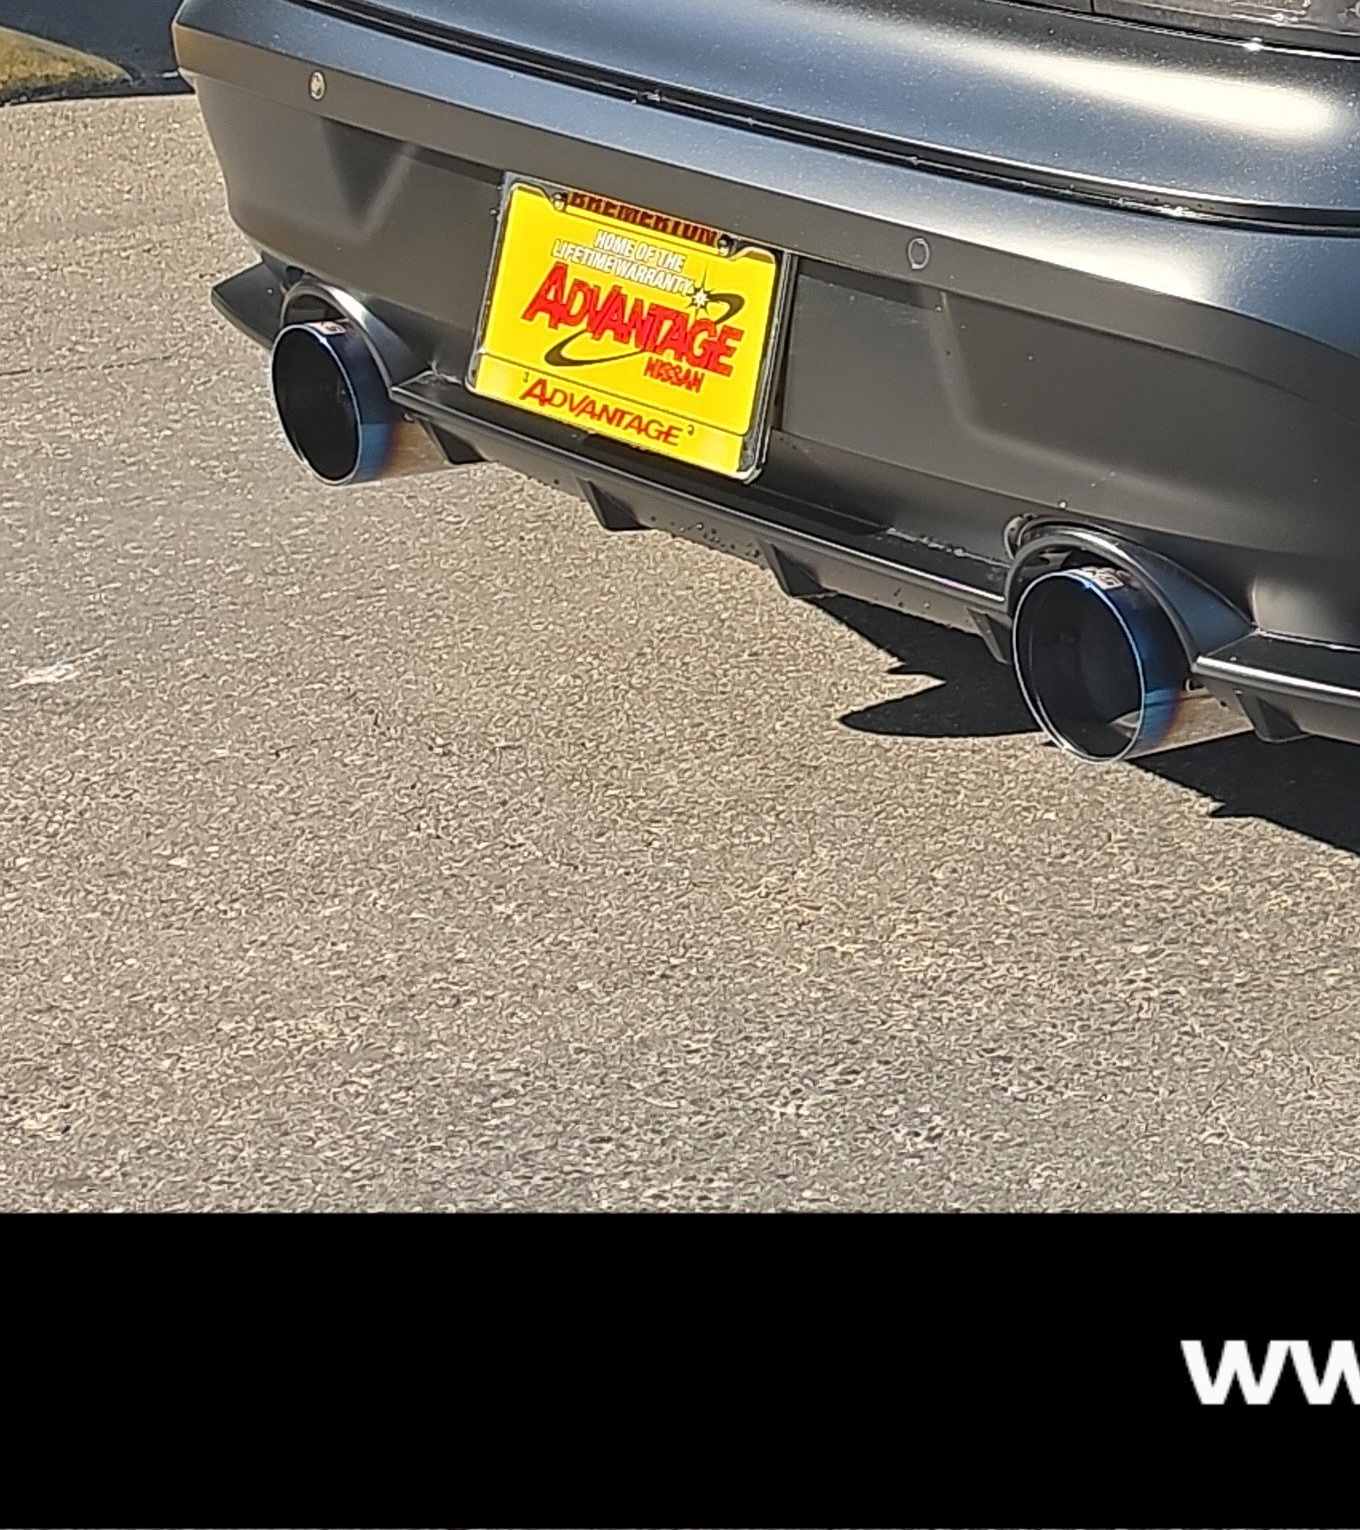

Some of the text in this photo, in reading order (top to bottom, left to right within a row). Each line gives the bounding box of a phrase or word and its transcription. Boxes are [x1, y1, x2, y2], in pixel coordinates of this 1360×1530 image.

[551, 239, 695, 297] LIFETIME WARRANTY
[594, 229, 688, 274] HOME OF THE
[521, 260, 744, 377] ADVANTAGE
[643, 357, 706, 394] NISSAN
[519, 378, 684, 447] ADVANTAGE
